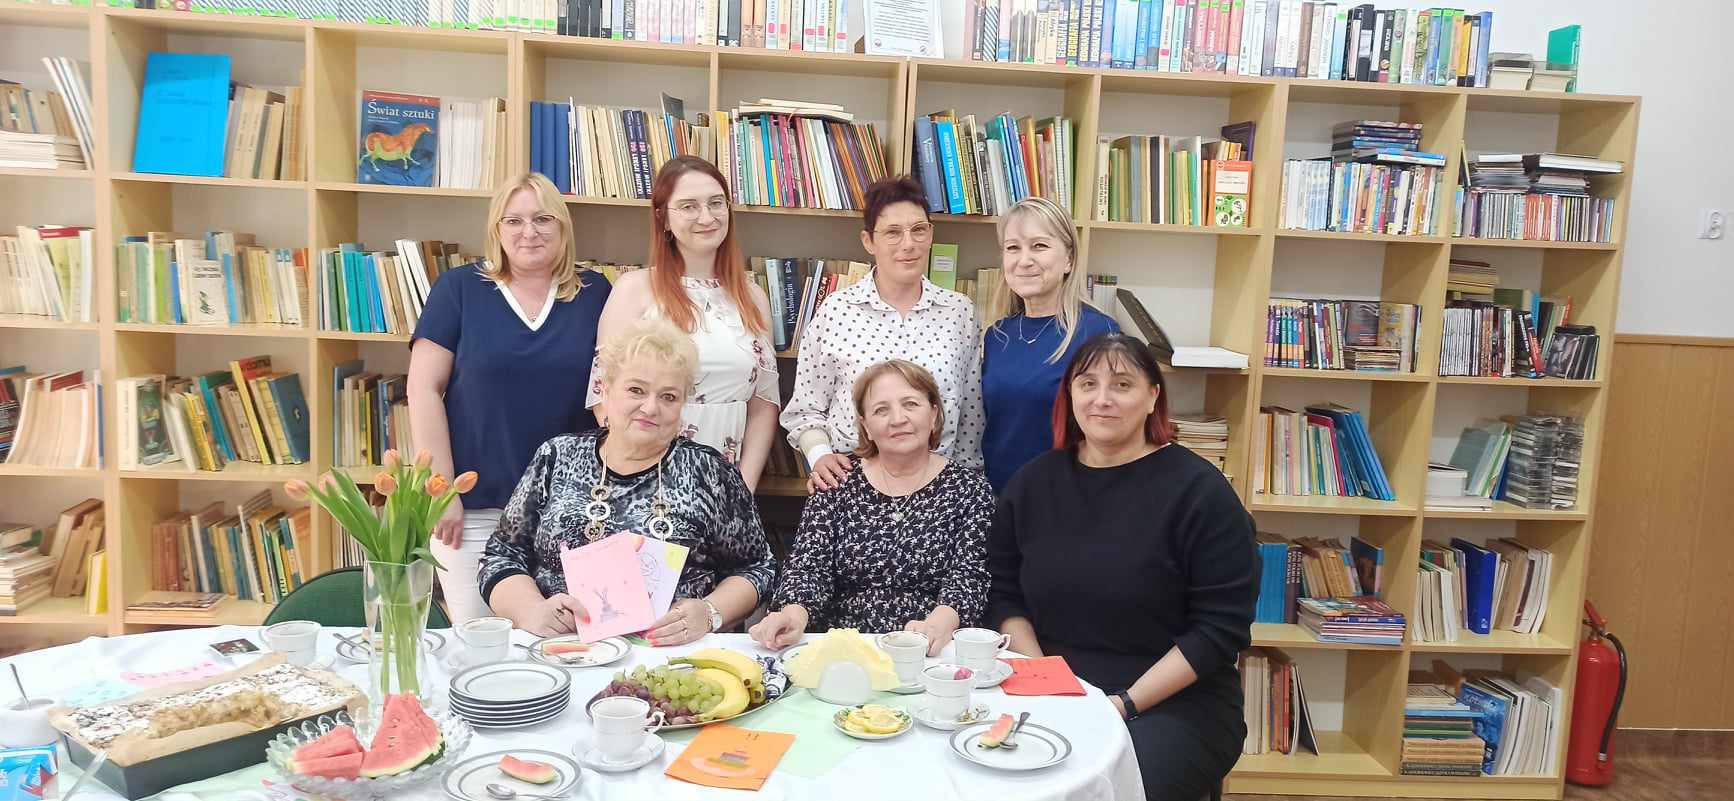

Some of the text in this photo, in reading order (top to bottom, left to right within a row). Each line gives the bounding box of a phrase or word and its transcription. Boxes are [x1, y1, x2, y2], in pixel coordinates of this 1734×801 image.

[367, 98, 400, 116] Świat
[402, 109, 435, 120] sztuki
[632, 153, 640, 172] LEKCJI
[635, 173, 644, 195] MUZYKI
[784, 283, 797, 324] Psychologia
